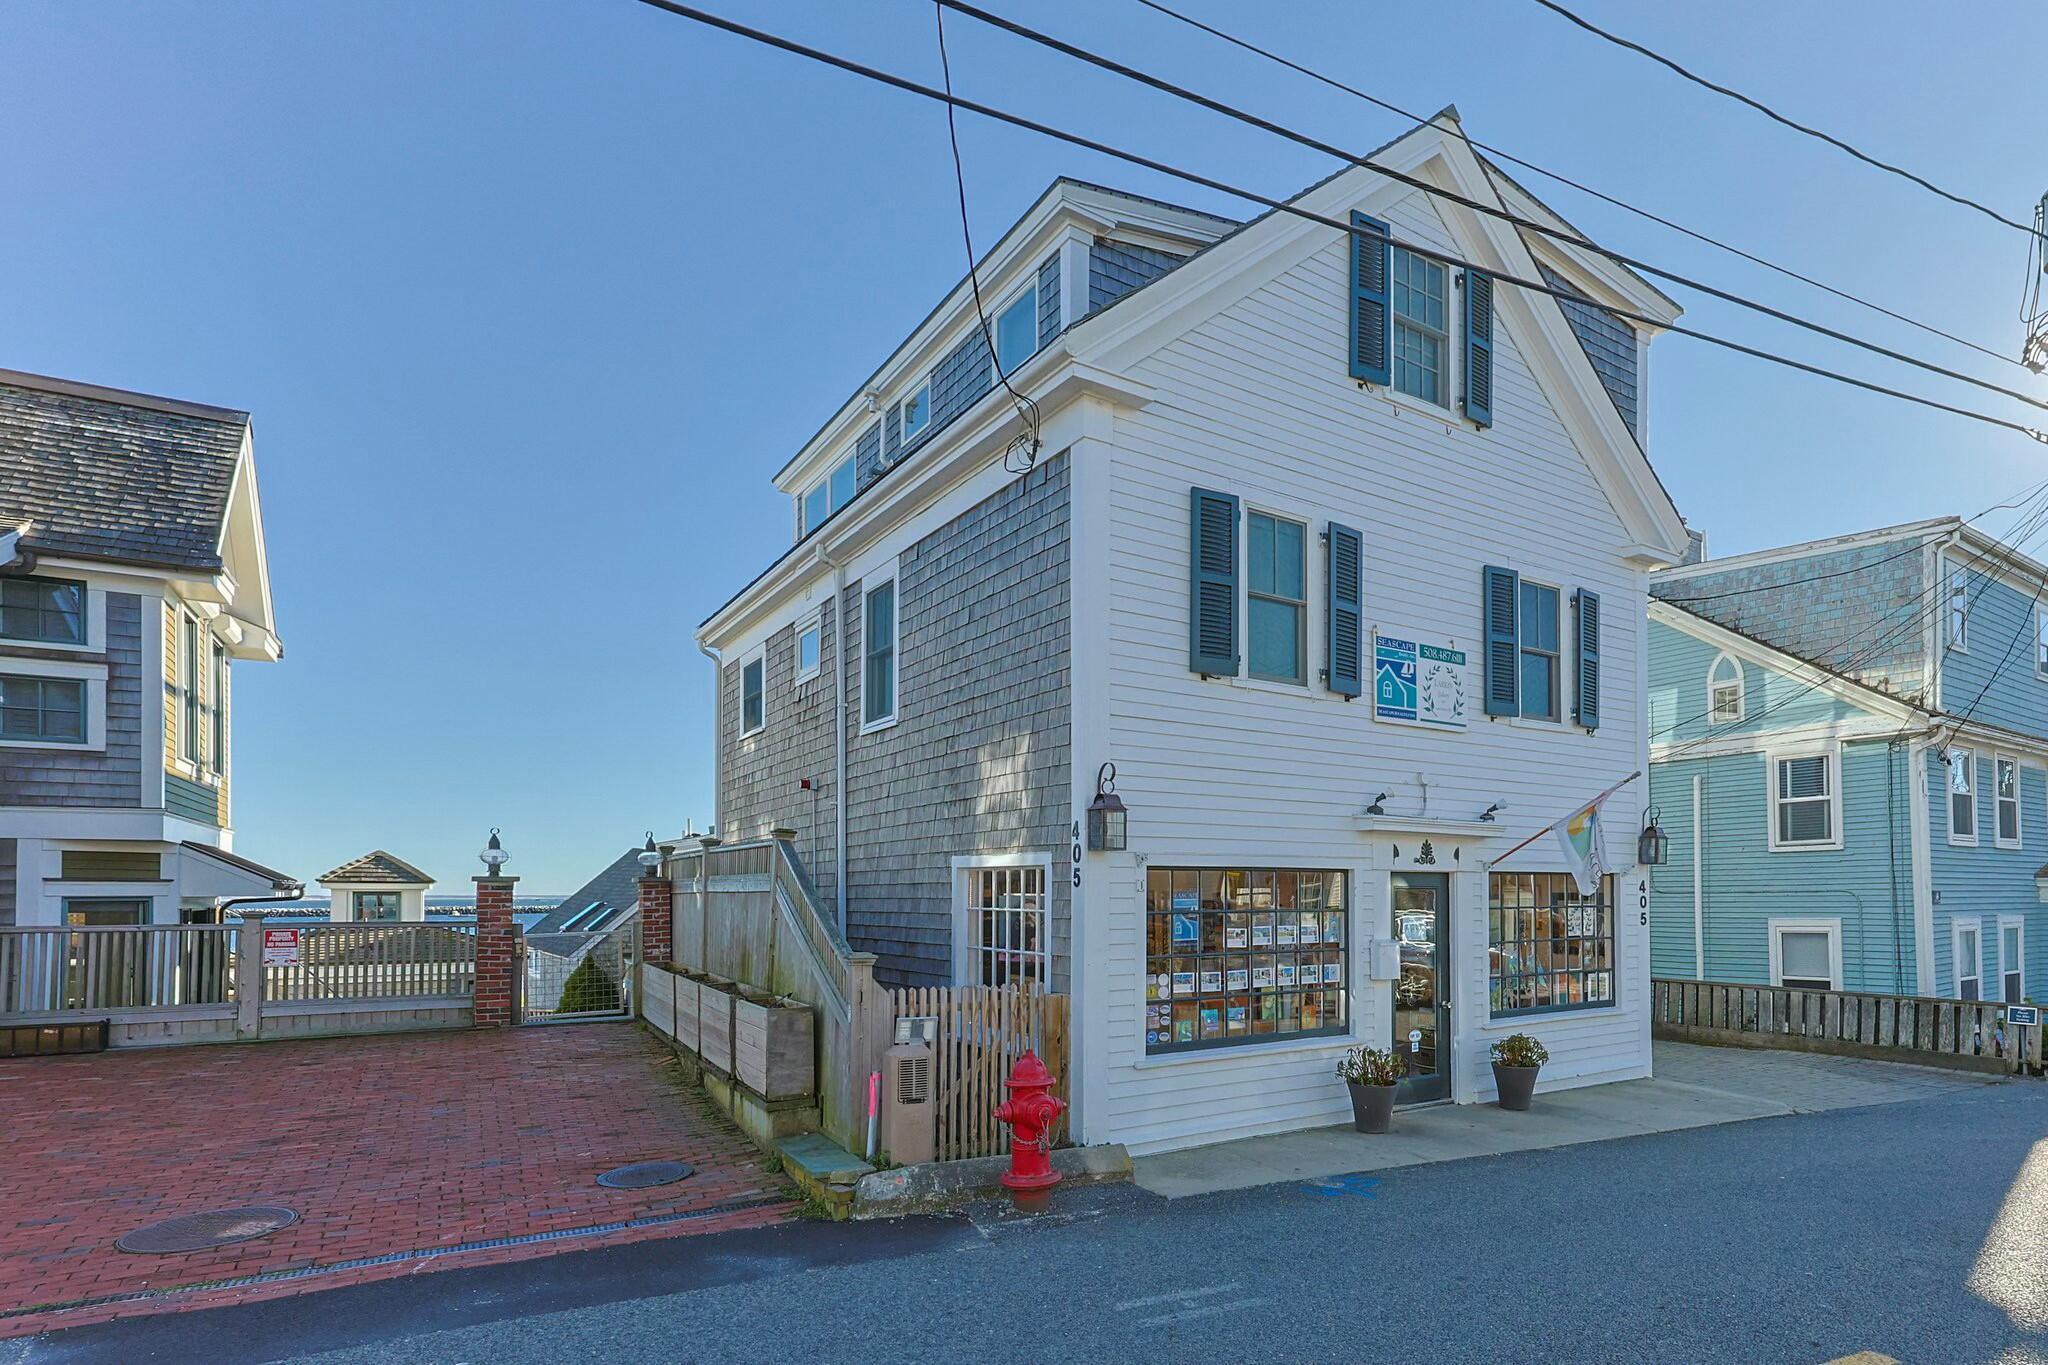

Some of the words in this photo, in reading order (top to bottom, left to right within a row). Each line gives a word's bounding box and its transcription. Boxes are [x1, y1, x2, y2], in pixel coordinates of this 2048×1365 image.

[1377, 637, 1415, 652] SEASCAPE
[1423, 646, 1463, 664] 508.487.6111
[1072, 820, 1082, 888] 405
[1639, 879, 1647, 926] 405
